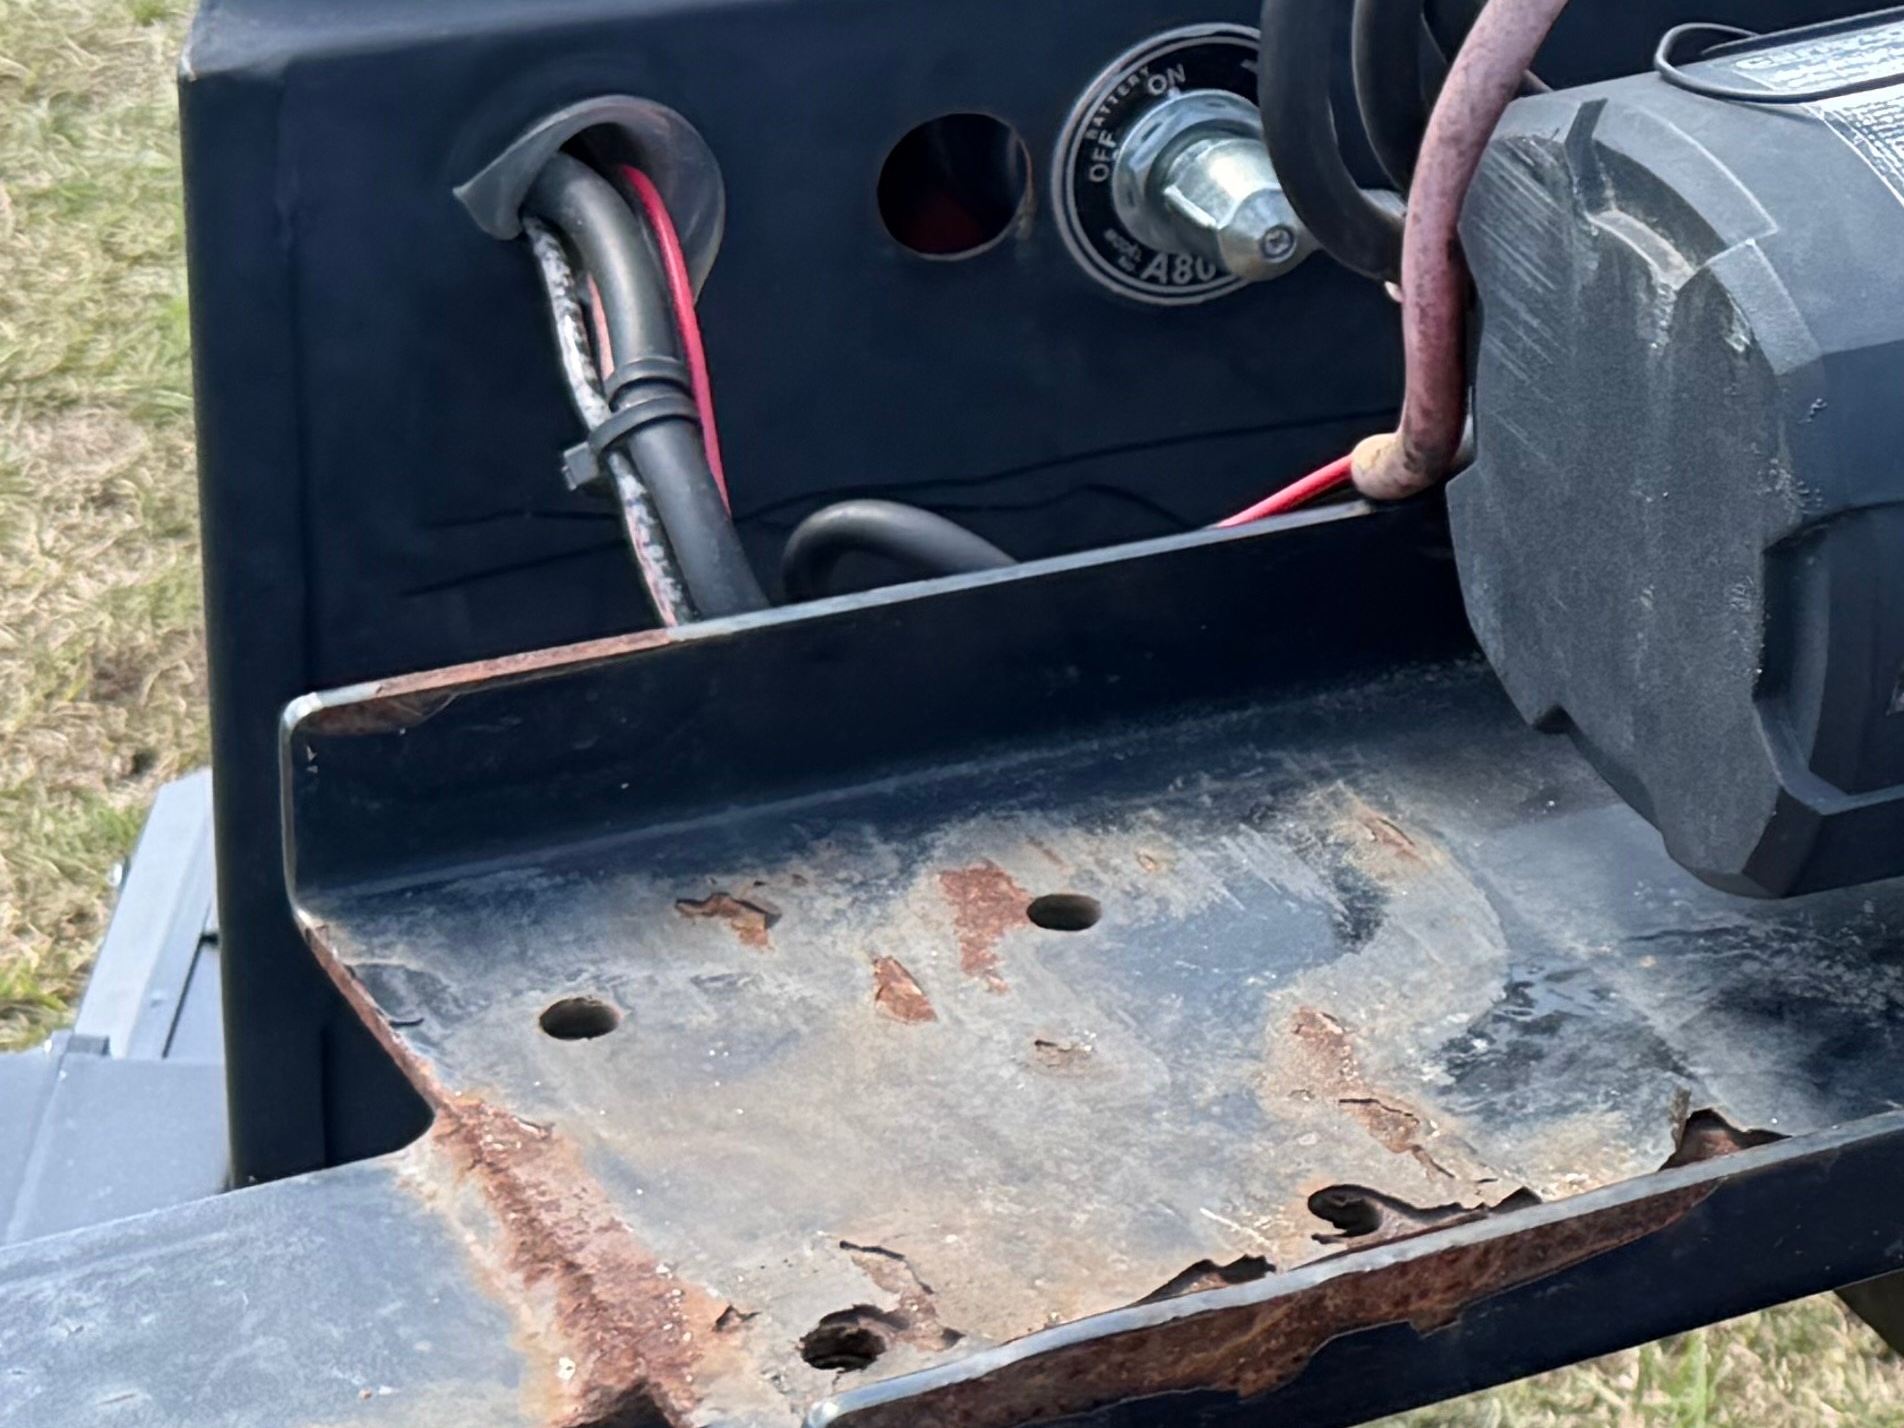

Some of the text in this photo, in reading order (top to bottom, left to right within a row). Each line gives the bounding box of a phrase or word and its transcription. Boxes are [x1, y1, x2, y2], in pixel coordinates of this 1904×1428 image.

[1085, 66, 1150, 140] BATTERY
[1148, 63, 1187, 95] ON
[1088, 130, 1118, 183] OFF
